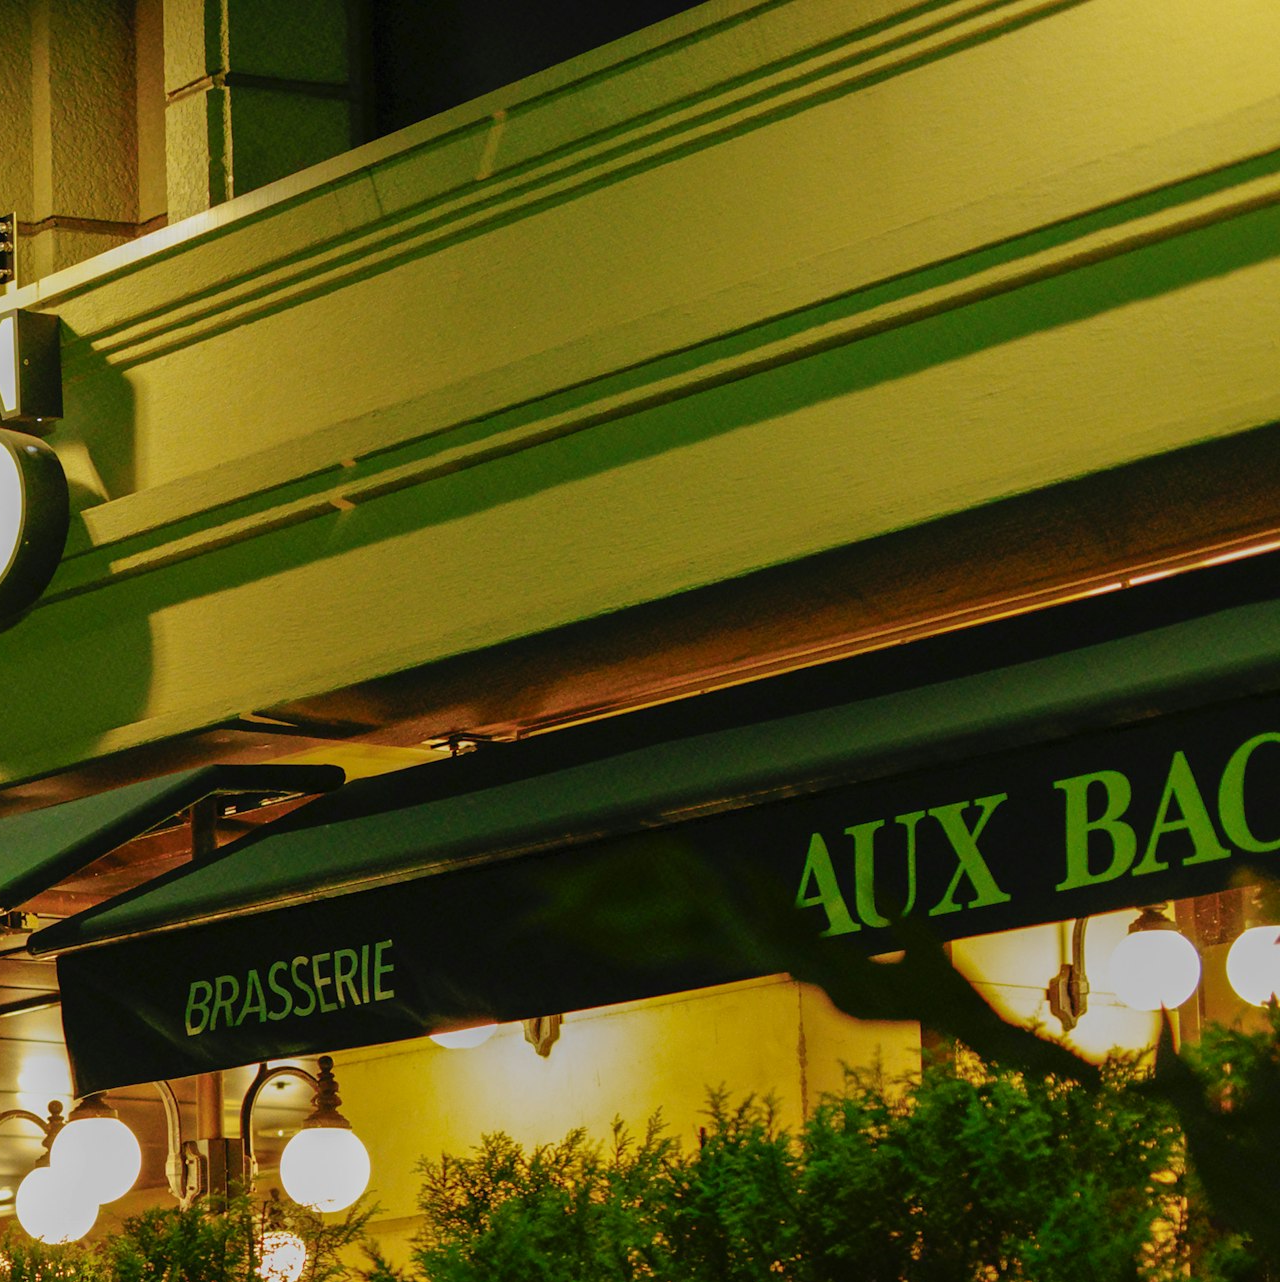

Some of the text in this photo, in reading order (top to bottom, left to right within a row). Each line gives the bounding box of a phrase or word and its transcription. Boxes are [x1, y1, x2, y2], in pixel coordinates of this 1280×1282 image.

[794, 731, 1280, 939] AUX BAC
[184, 938, 396, 1038] BRASSERIE
